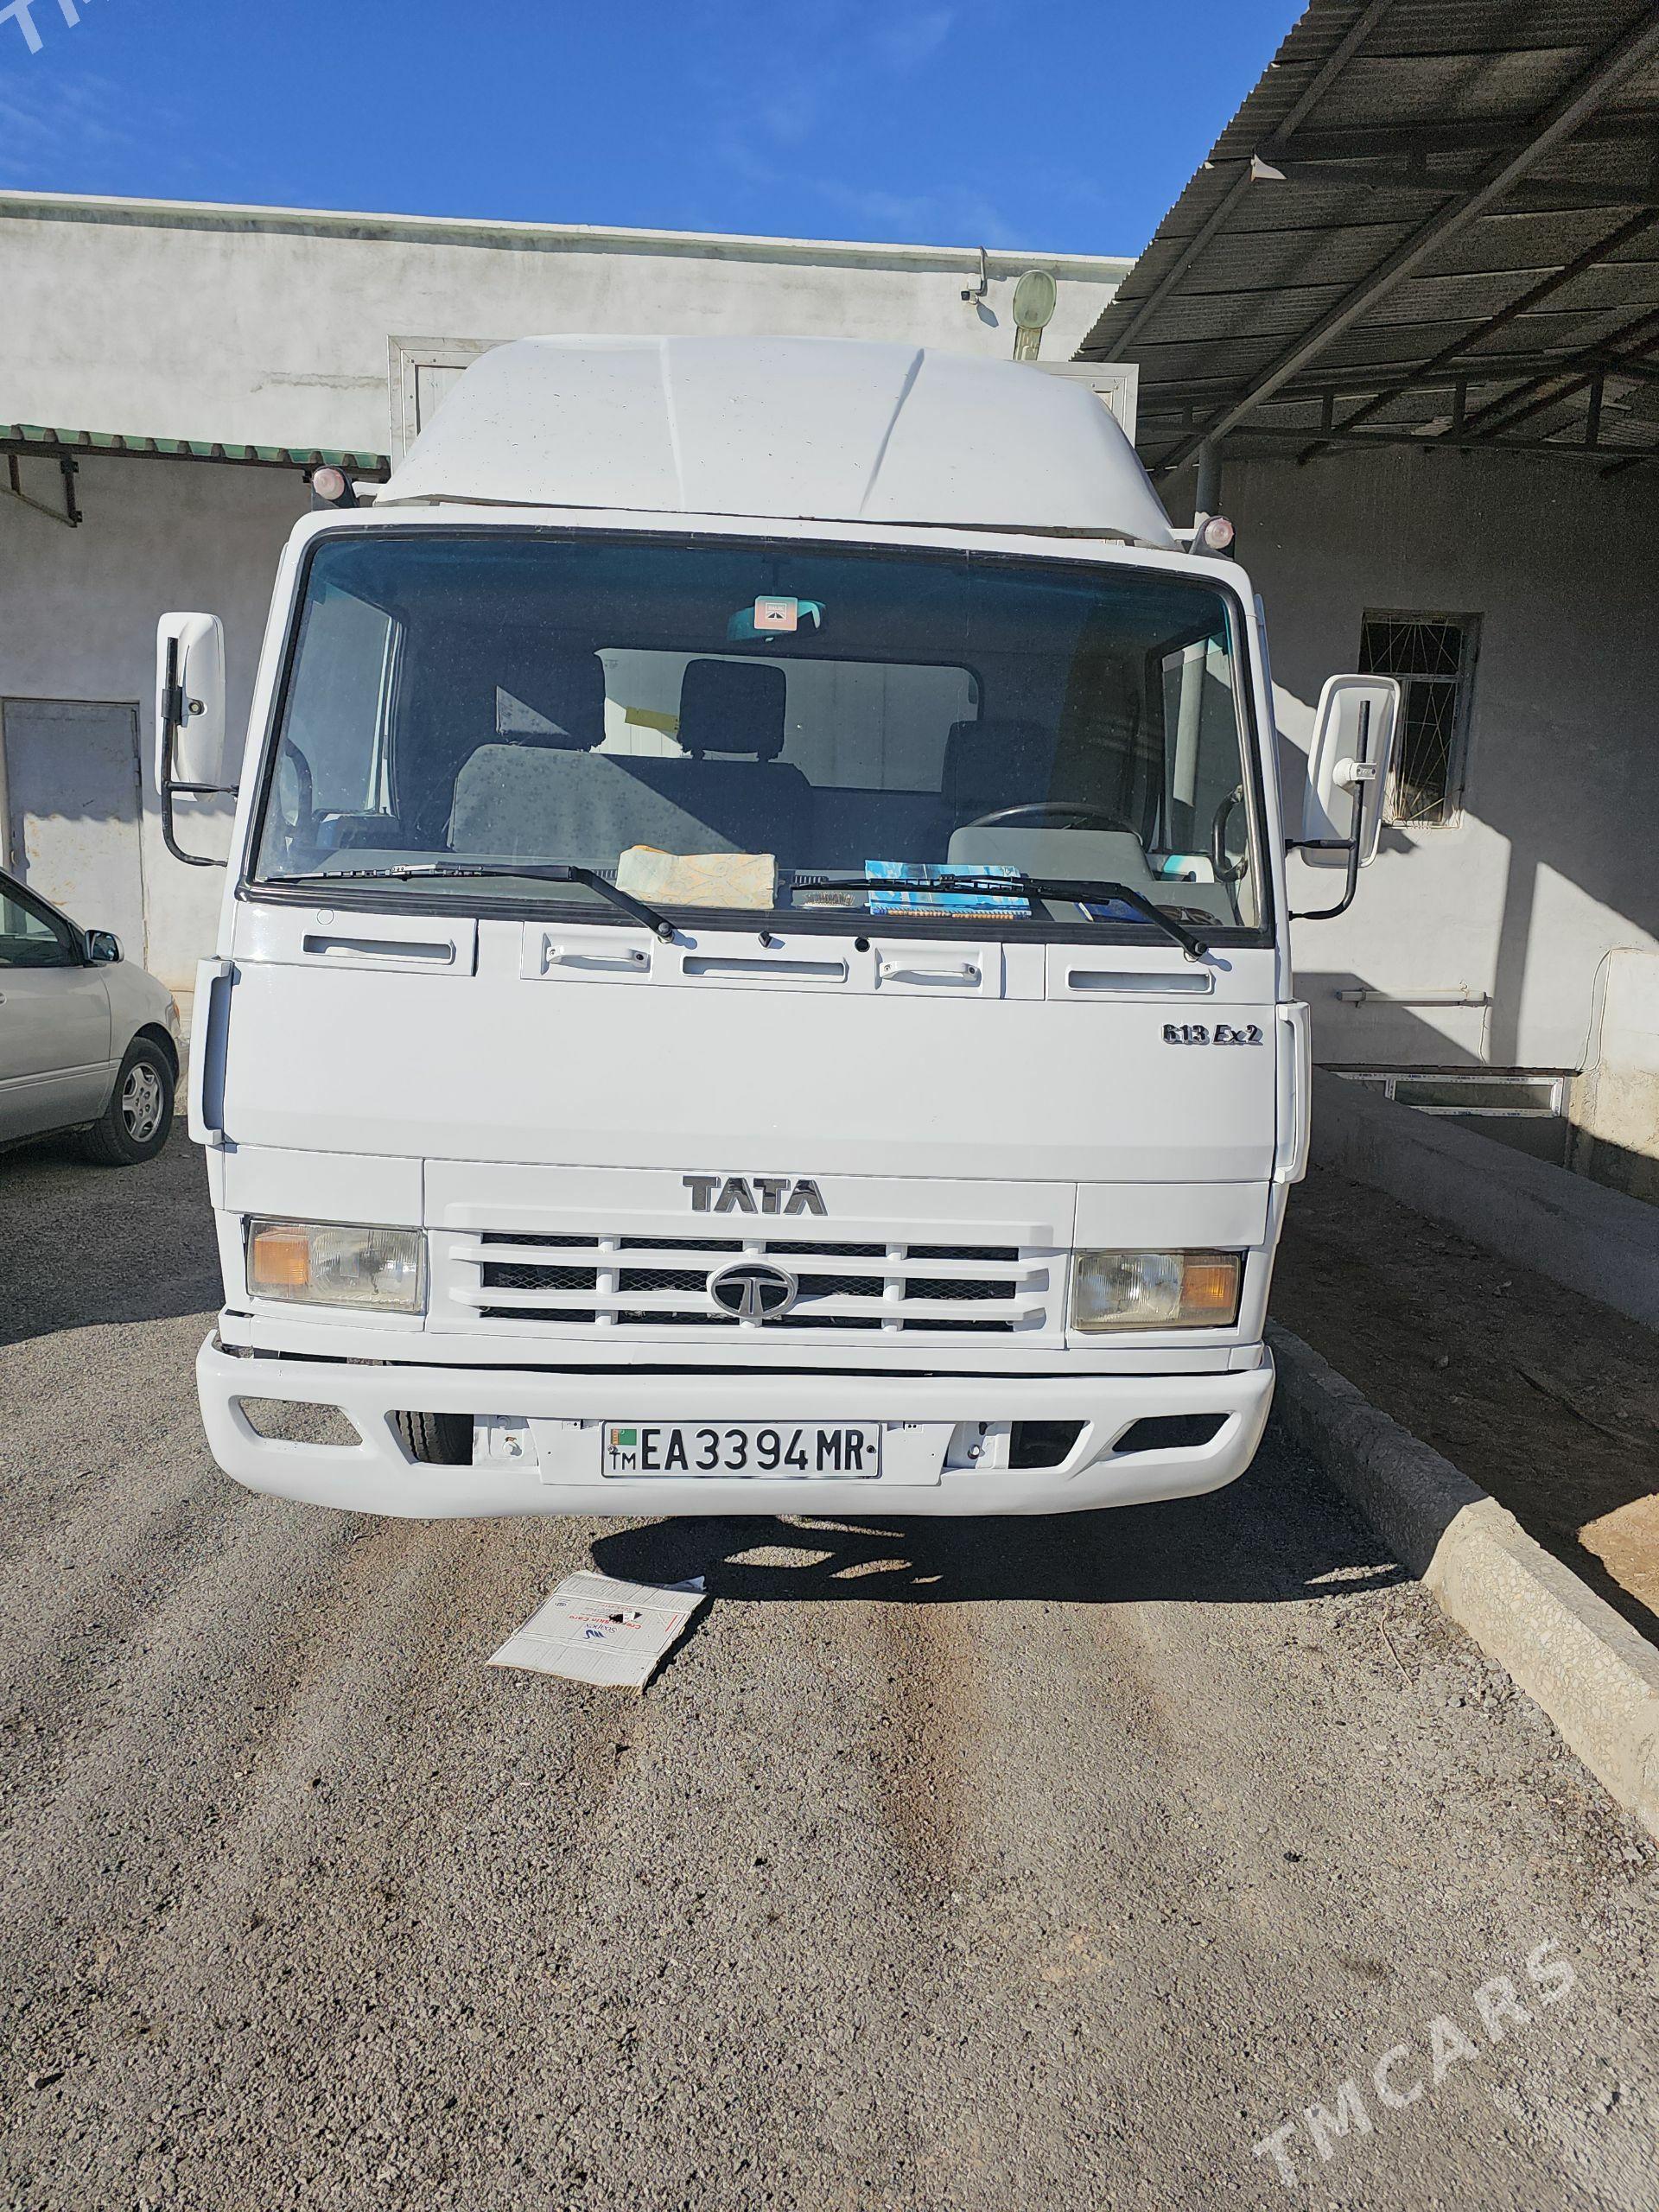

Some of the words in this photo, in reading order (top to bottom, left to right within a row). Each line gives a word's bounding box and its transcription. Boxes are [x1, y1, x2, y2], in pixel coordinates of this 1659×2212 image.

[1162, 1023, 1211, 1046] 613
[1212, 1023, 1263, 1046] Ex2
[682, 1175, 829, 1217] TATA
[608, 1451, 637, 1471] TM
